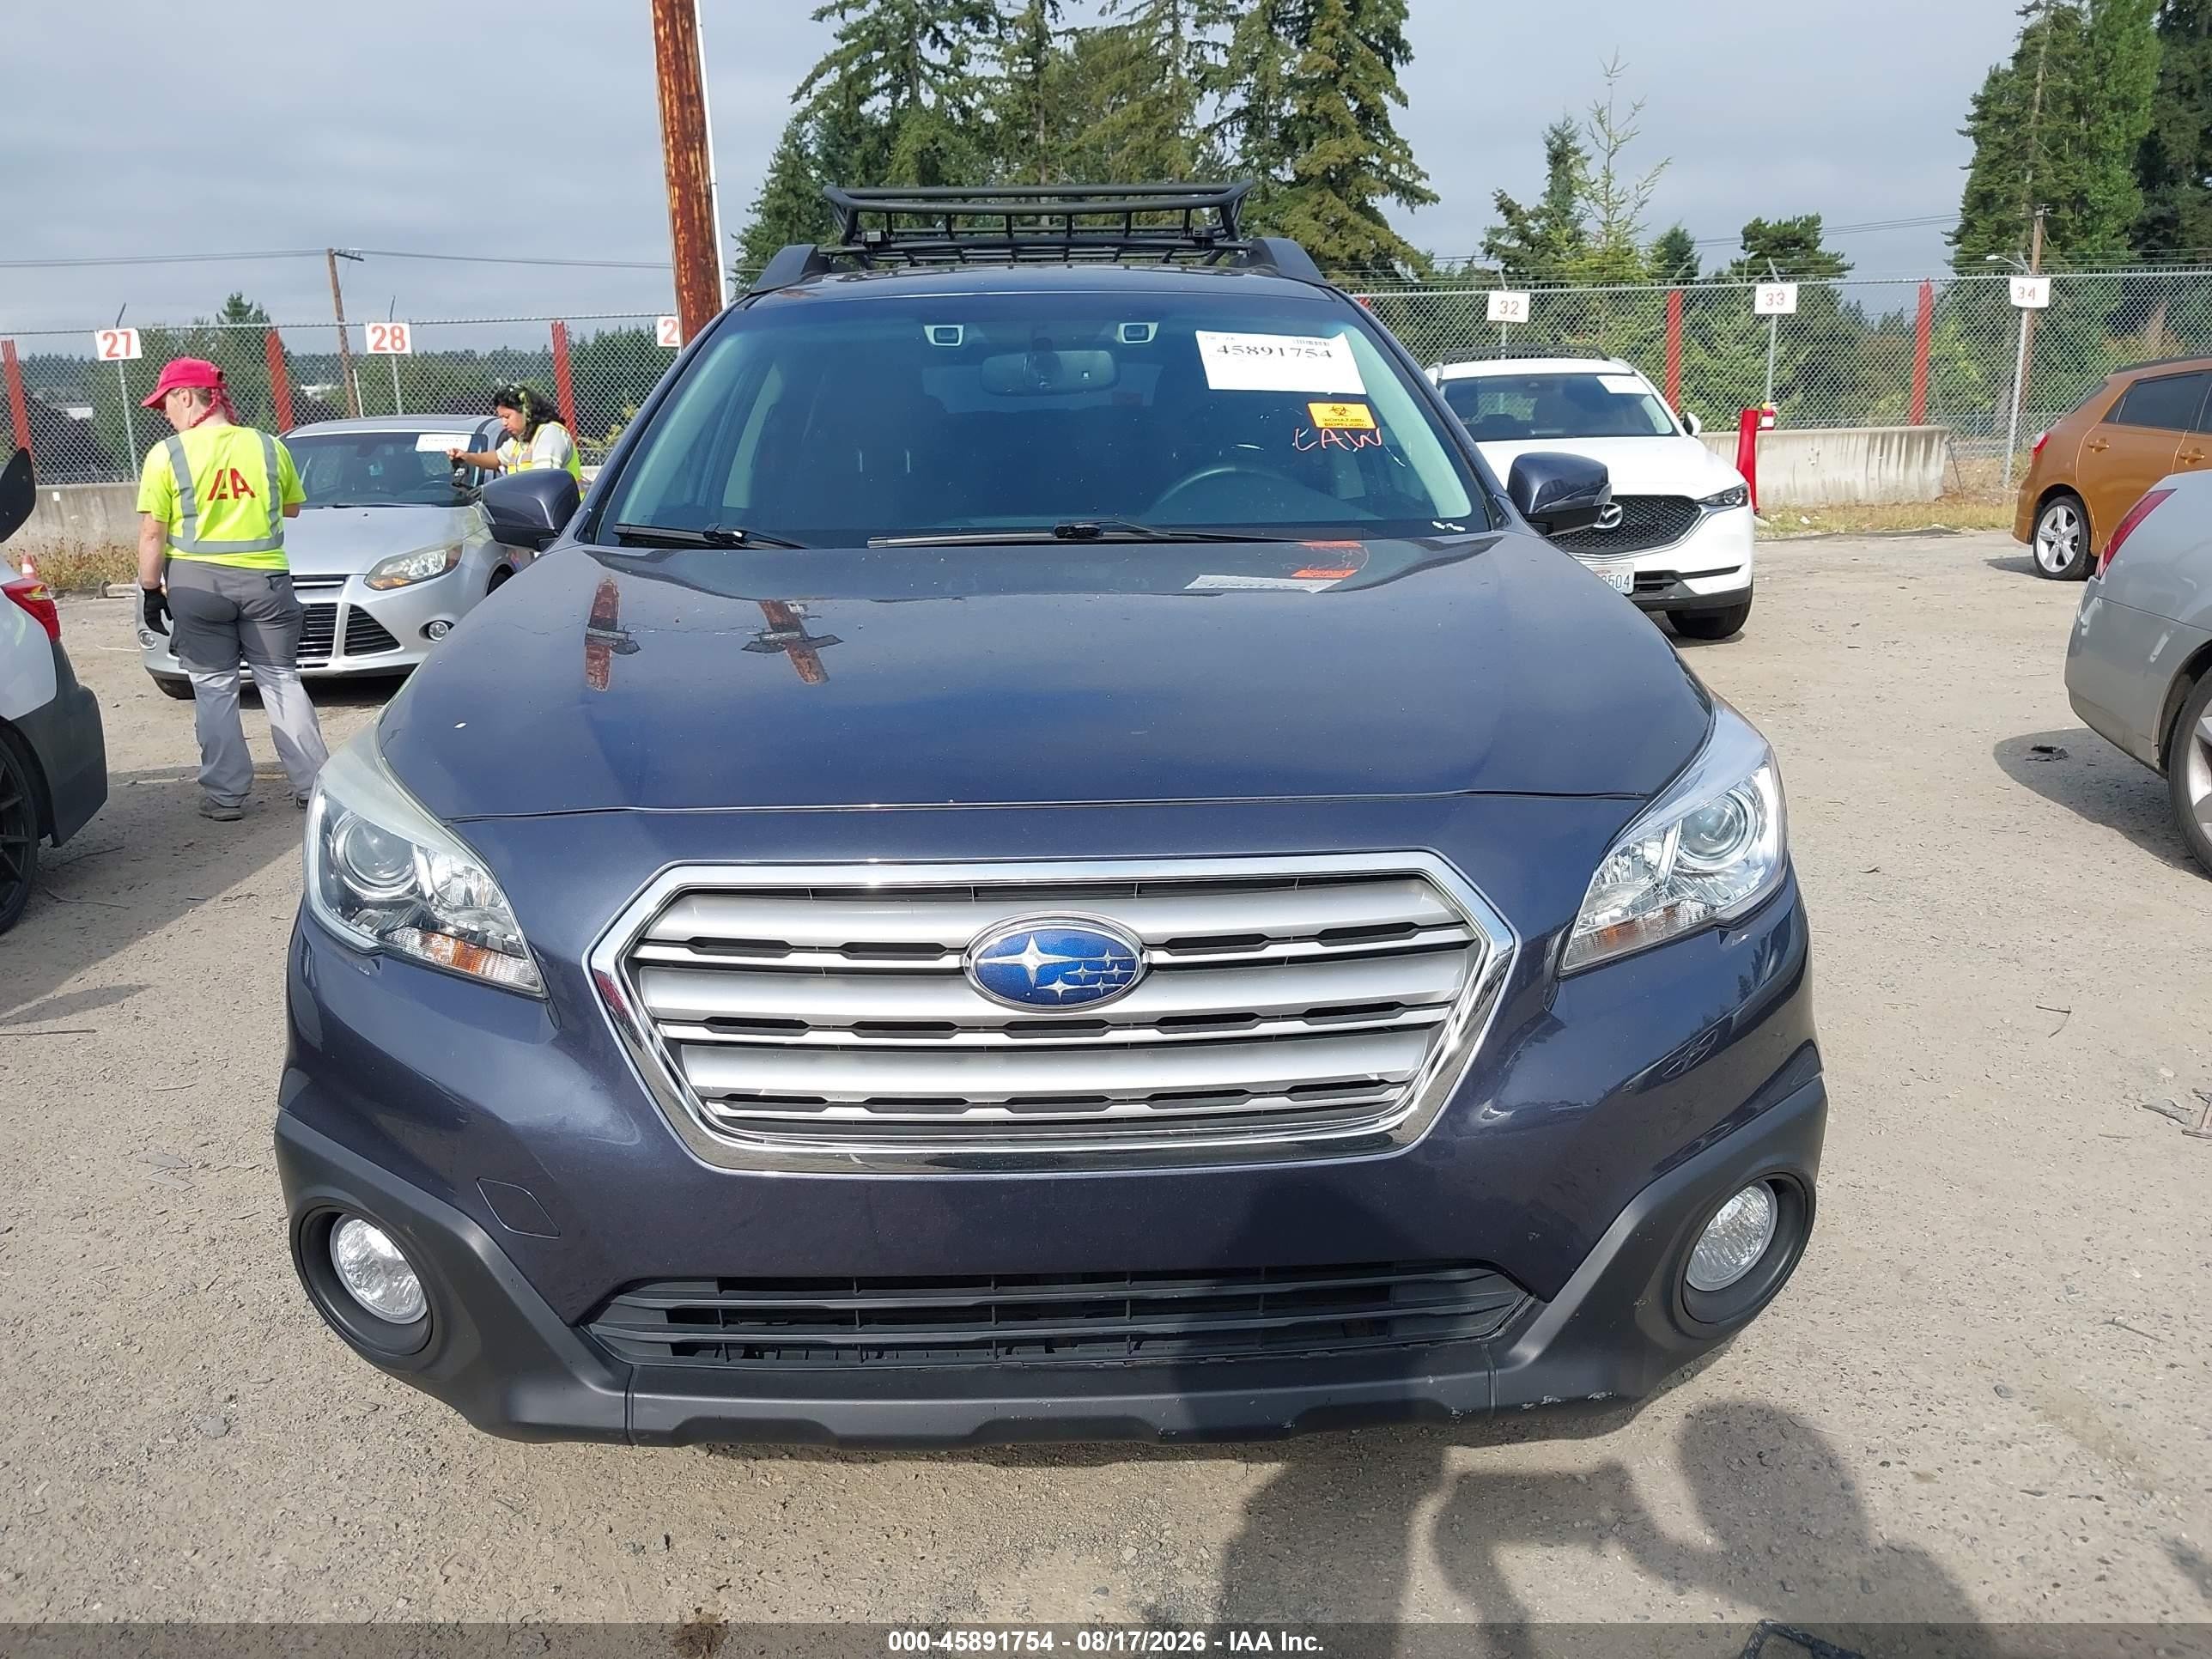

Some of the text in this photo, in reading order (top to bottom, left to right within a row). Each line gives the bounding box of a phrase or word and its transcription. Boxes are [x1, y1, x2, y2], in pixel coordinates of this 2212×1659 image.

[1765, 291, 1786, 307] 33
[2016, 285, 2036, 301] 34
[1499, 300, 1520, 316] 32
[371, 325, 406, 352] 28
[662, 319, 679, 344] 2
[101, 331, 132, 358] 27
[1217, 344, 1334, 359] 45891754
